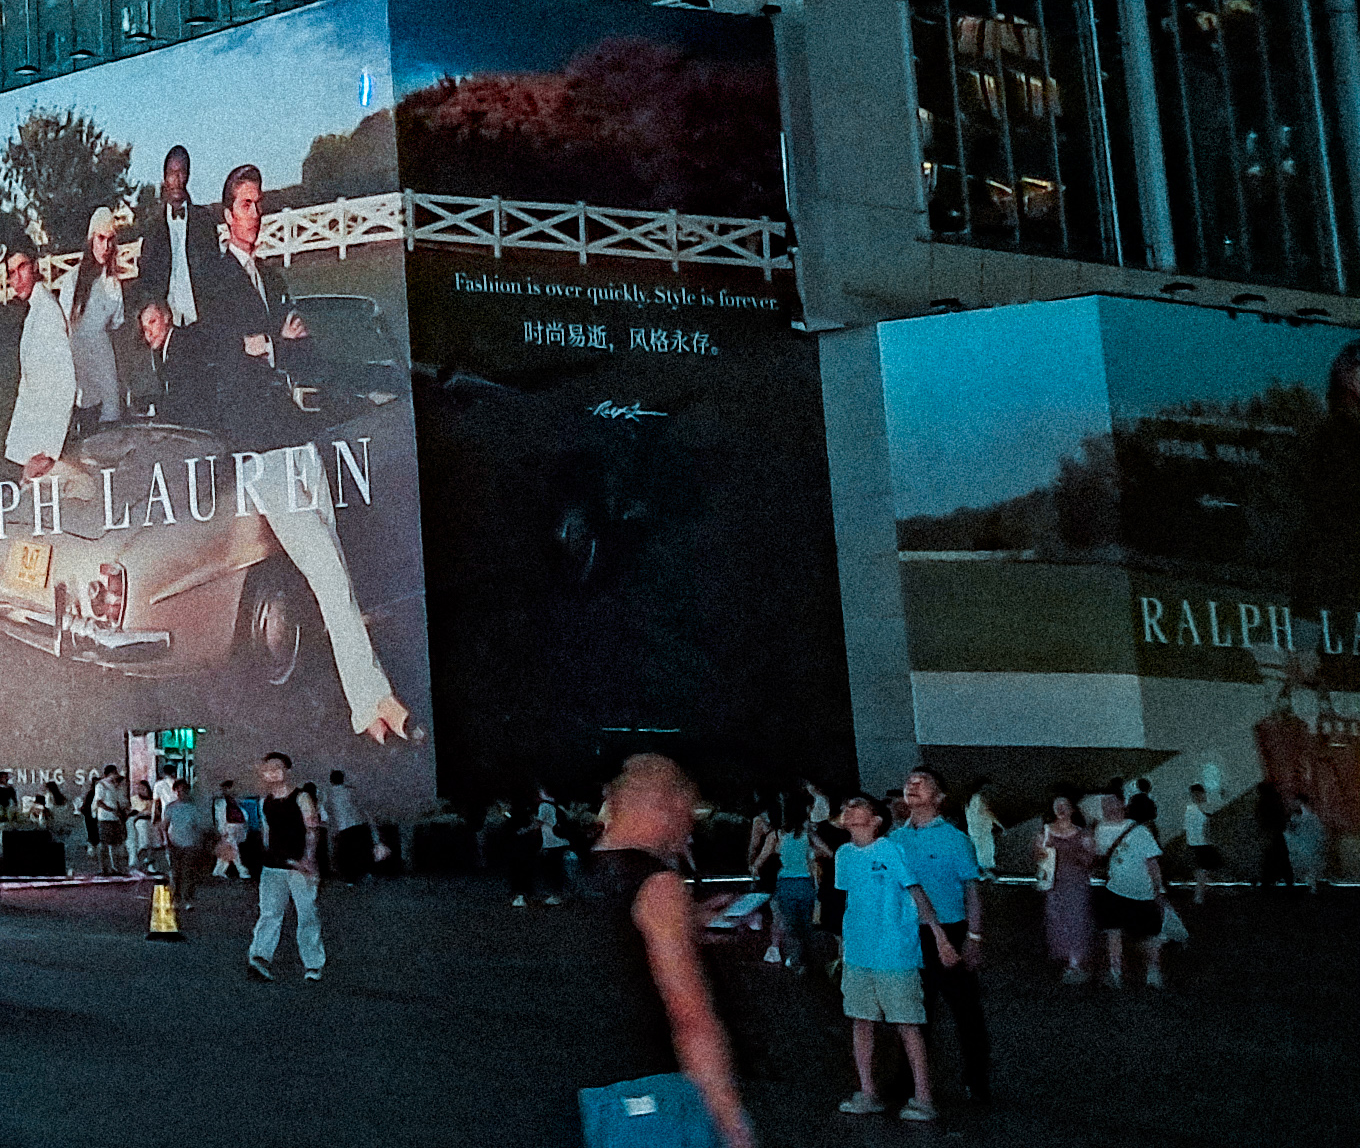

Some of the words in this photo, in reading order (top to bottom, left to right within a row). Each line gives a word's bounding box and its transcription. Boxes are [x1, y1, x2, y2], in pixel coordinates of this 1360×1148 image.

[454, 271, 523, 295] Fashion
[526, 276, 541, 295] is
[545, 283, 582, 299] over
[586, 284, 650, 309] quickly.
[654, 286, 696, 311] Style
[701, 288, 715, 307] is
[719, 290, 780, 311] forever.
[100, 437, 373, 531] LAUREN
[1140, 596, 1296, 652] RALPH
